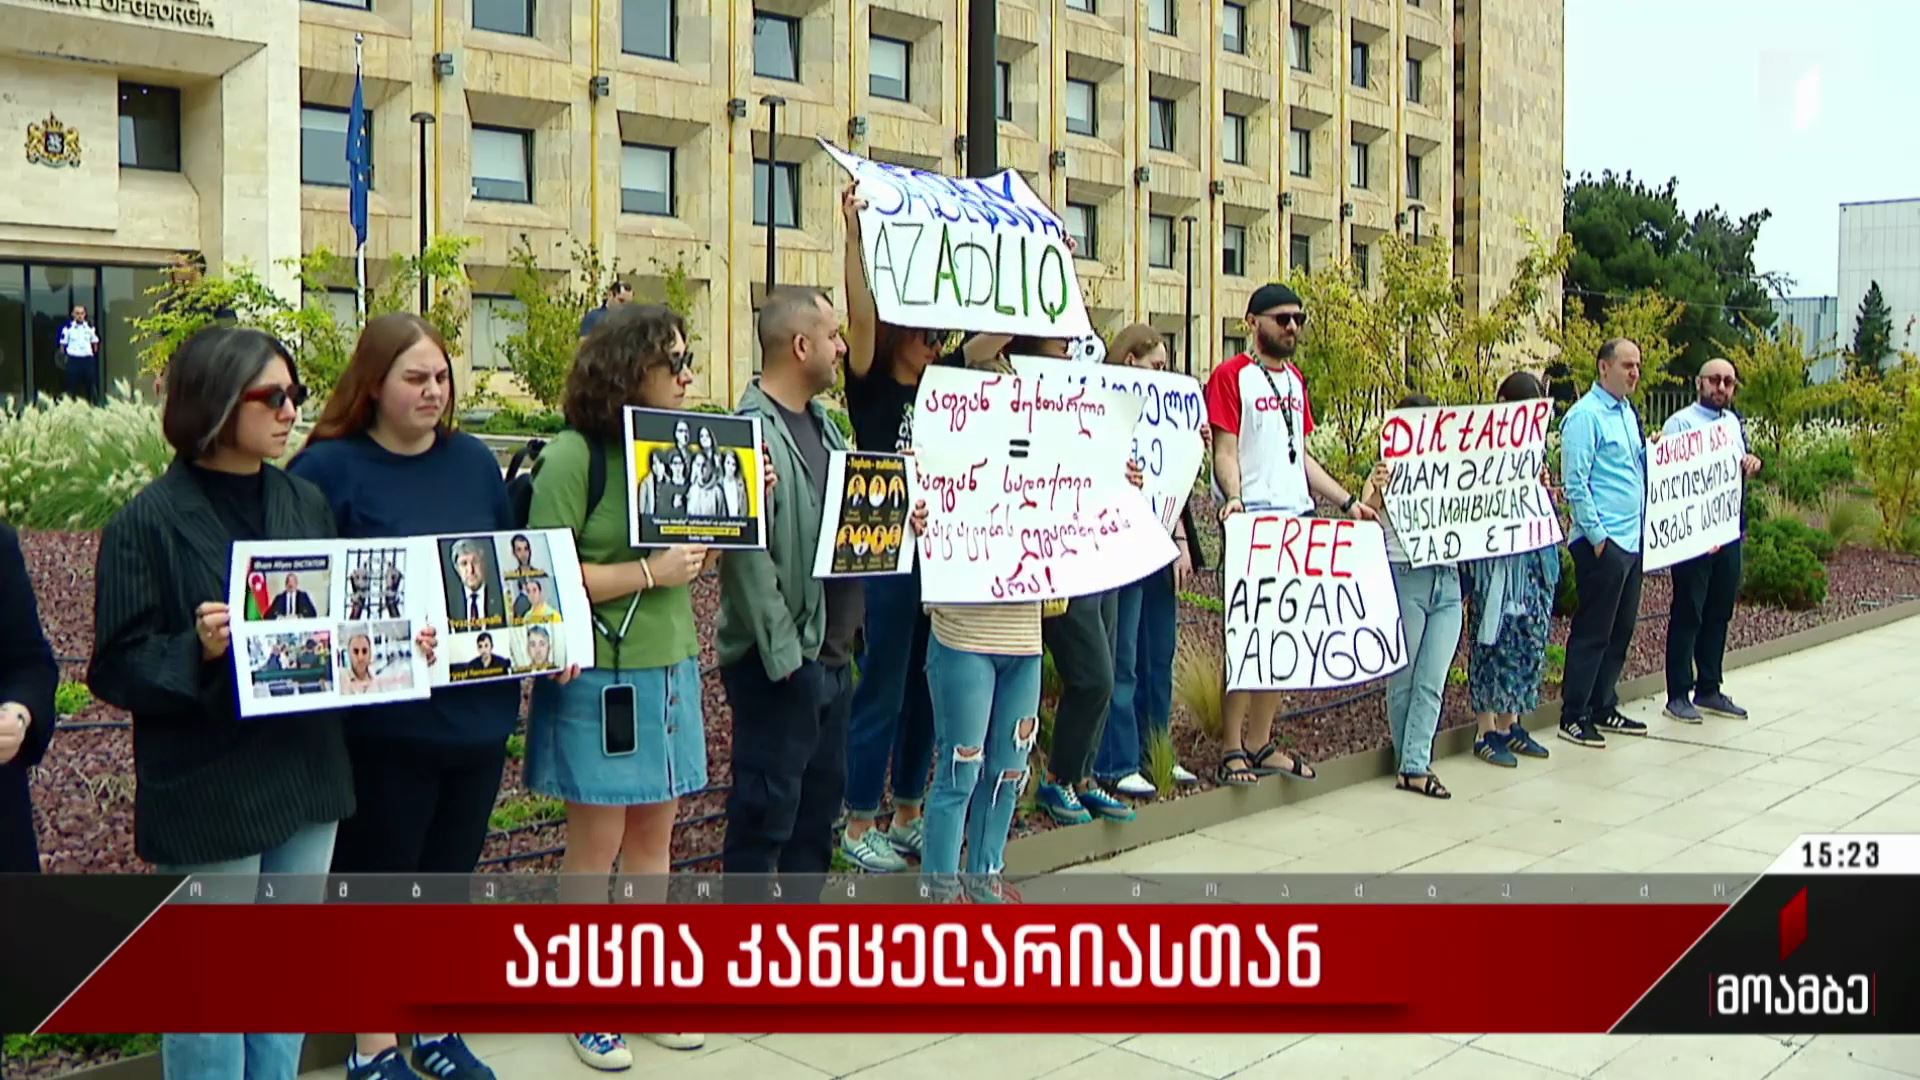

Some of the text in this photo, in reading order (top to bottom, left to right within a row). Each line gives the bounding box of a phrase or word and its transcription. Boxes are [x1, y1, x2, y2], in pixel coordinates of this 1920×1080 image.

[130, 0, 215, 28] GEORGIA
[873, 221, 1068, 324] AZADLIQ
[1651, 453, 1738, 505] სოლიდარობა
[1247, 515, 1355, 578] FREE
[1649, 504, 1695, 549] აფგან
[1227, 577, 1366, 627] AFGAN
